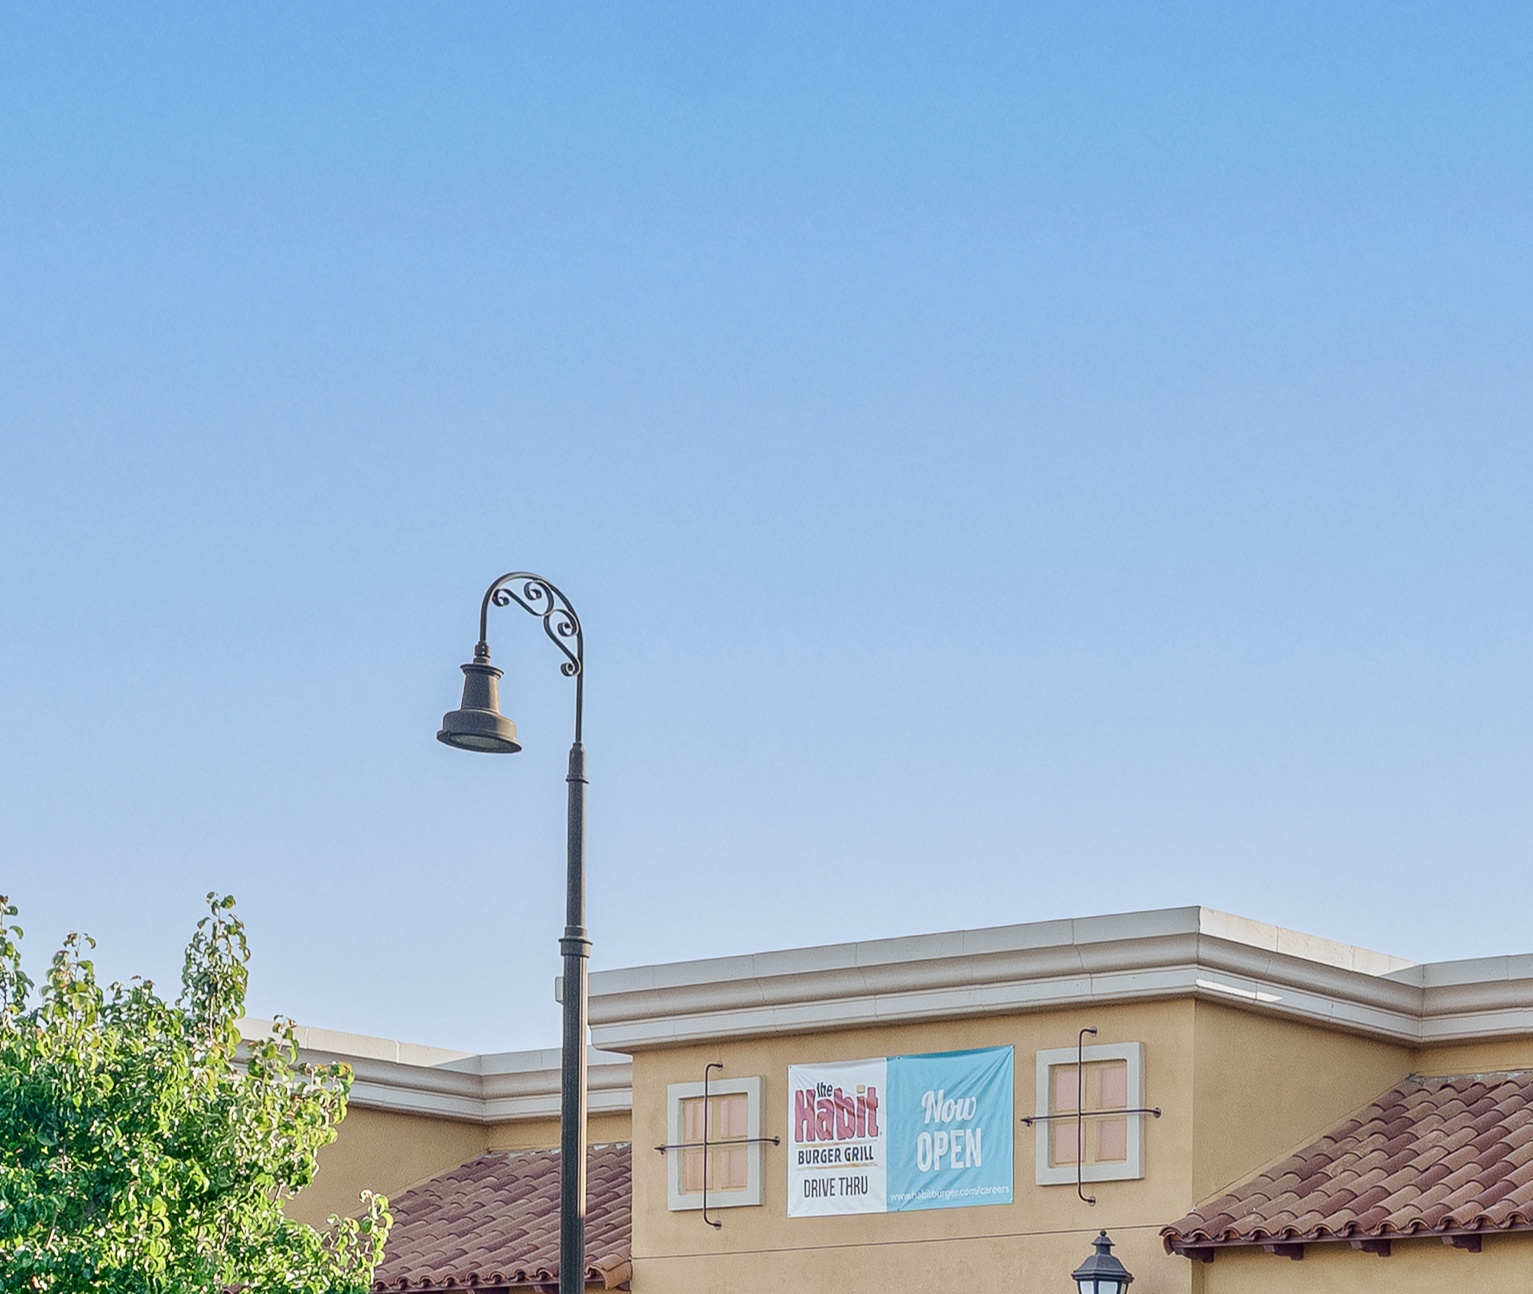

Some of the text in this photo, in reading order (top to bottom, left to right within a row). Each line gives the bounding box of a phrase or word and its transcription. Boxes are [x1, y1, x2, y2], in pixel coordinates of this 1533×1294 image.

[816, 1082, 833, 1098] the
[794, 1085, 879, 1143] Habit
[921, 1089, 977, 1124] Now
[798, 1145, 874, 1165] BURGER GRILL
[917, 1128, 982, 1172] OPEN
[804, 1175, 868, 1198] DRIVE THRU
[889, 1184, 1010, 1202] www.habitburger.com/careers
